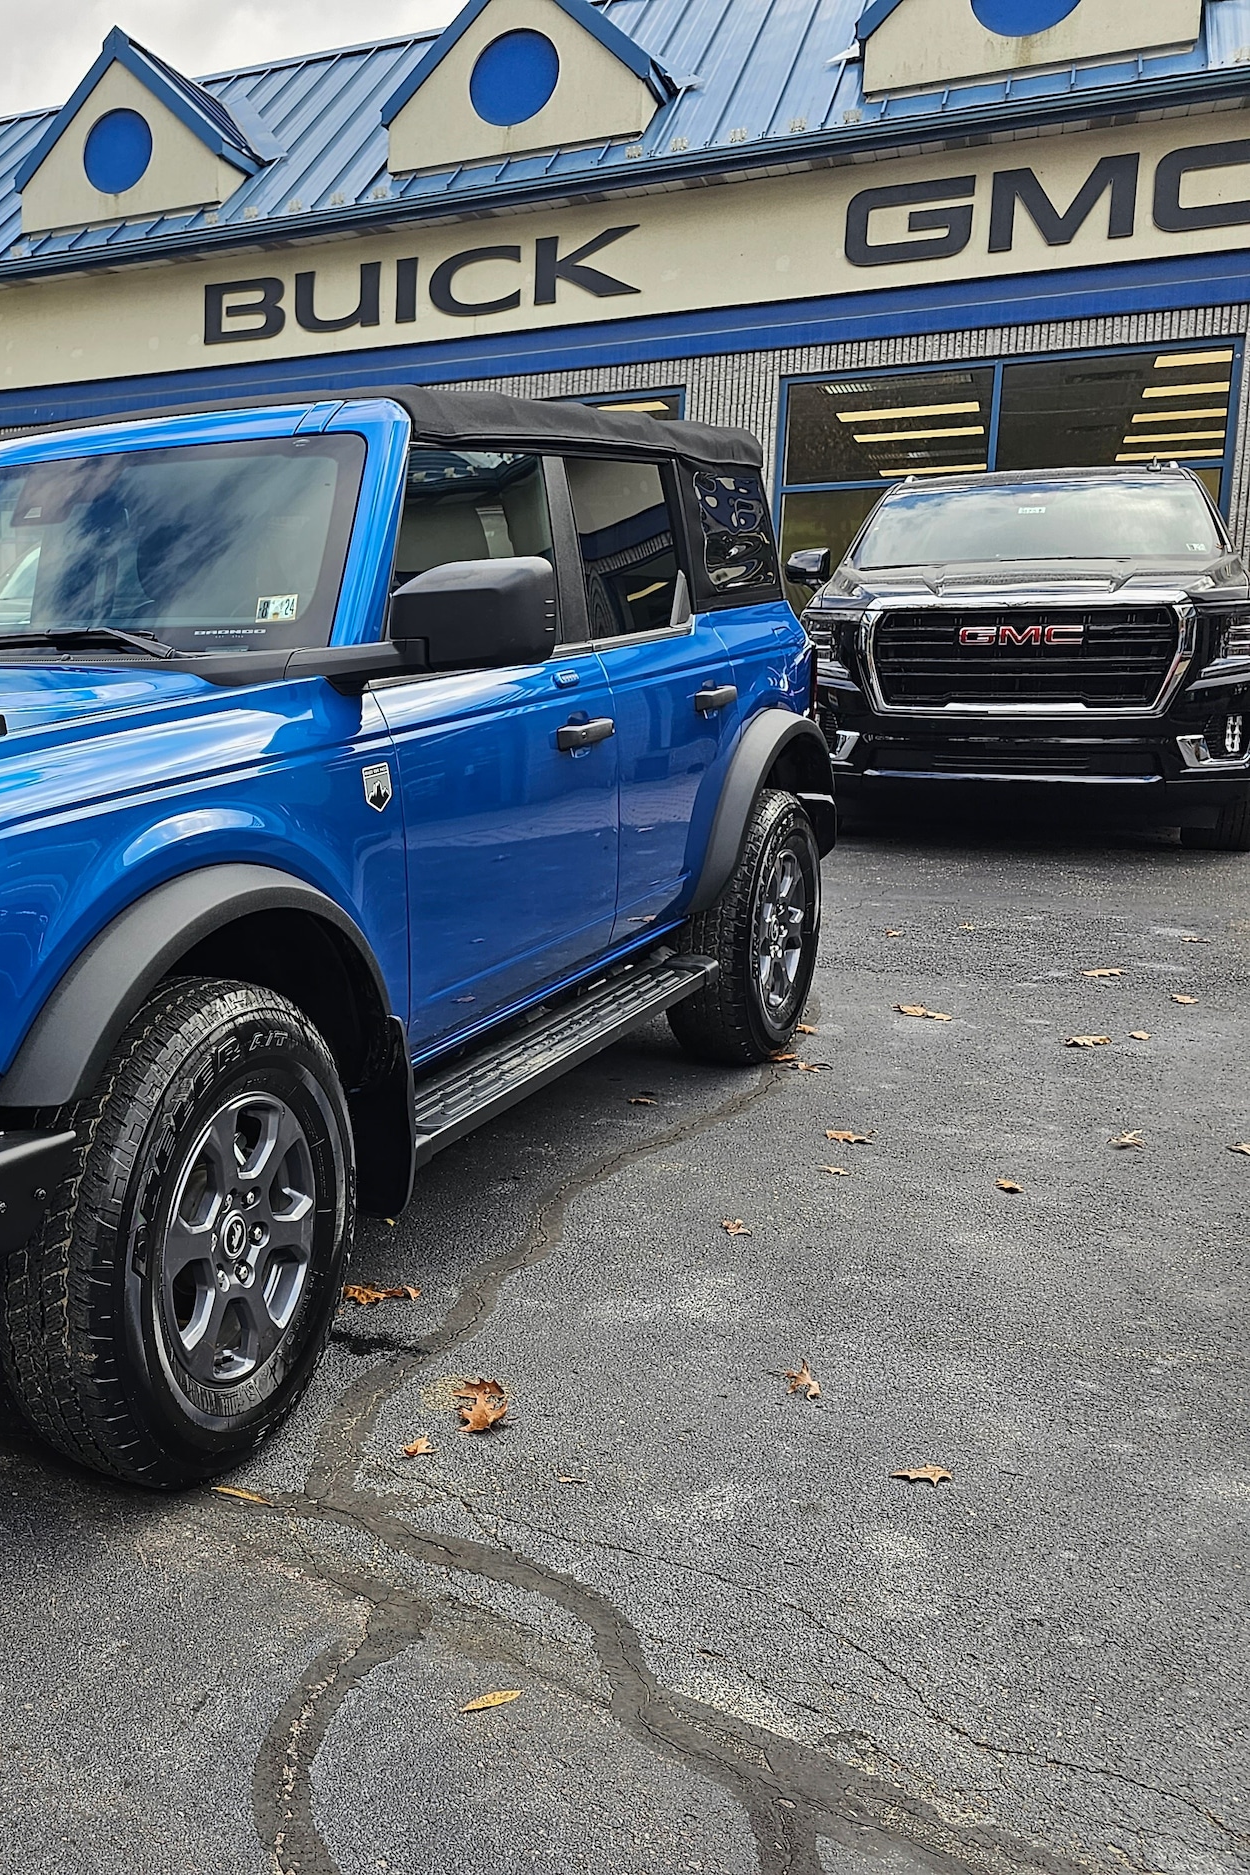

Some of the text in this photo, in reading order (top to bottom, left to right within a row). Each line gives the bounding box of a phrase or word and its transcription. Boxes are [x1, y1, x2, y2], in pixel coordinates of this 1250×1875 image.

[845, 139, 1250, 267] GMC
[203, 224, 641, 345] BUICK
[959, 625, 1084, 645] GMC
